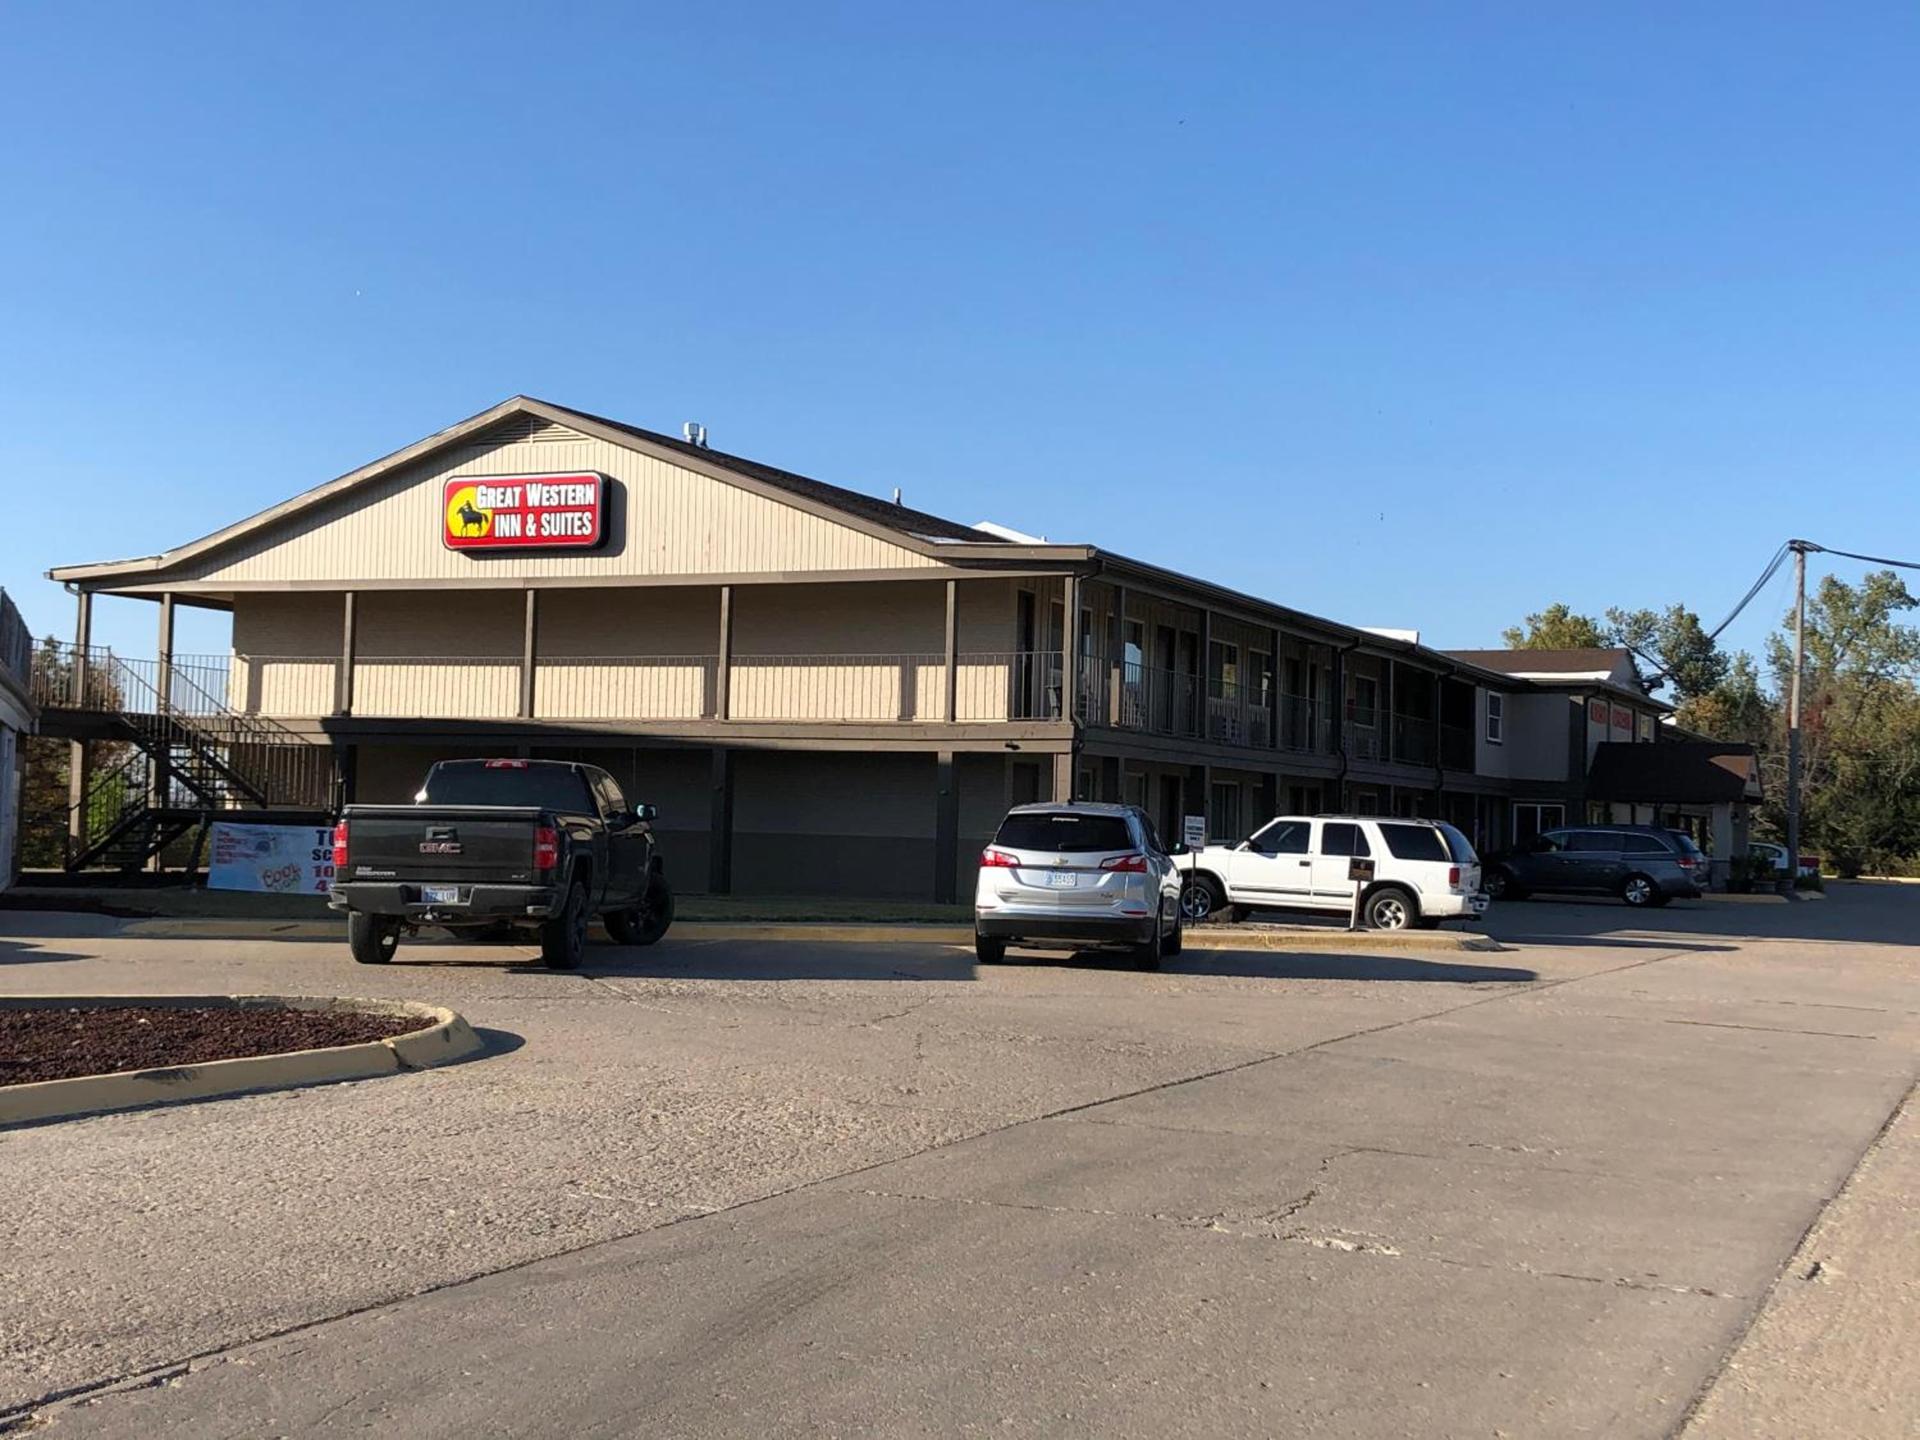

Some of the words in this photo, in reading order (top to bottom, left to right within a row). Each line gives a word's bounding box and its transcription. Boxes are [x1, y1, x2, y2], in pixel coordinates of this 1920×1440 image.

[477, 484, 522, 509] GREAT
[525, 482, 595, 507] WESTERN
[495, 514, 521, 537] INN
[525, 513, 537, 536] &
[541, 512, 592, 536] SUITES
[419, 843, 461, 853] GMC
